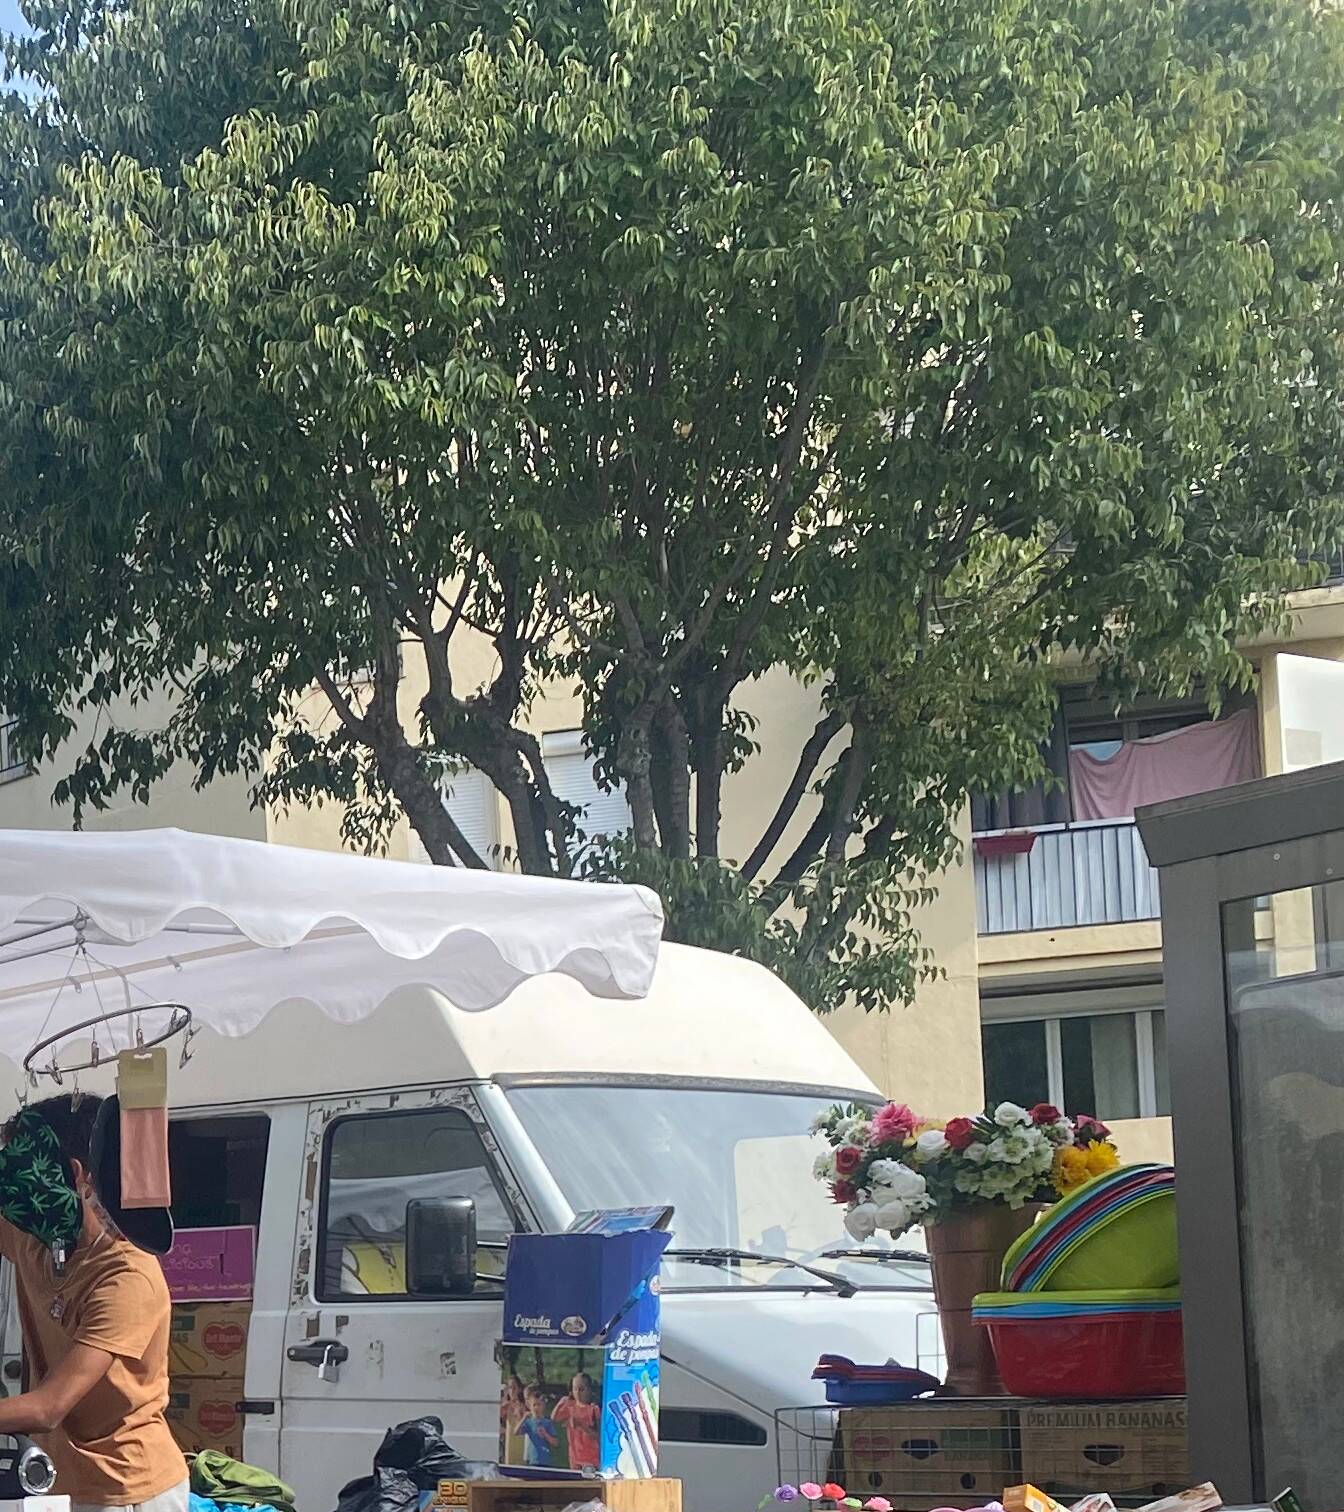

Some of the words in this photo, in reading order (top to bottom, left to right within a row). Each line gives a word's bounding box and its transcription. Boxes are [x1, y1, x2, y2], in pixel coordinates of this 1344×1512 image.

[513, 1313, 552, 1332] Espada
[1027, 1411, 1102, 1428] PREMIUM
[1105, 1411, 1186, 1428] BANANAS
